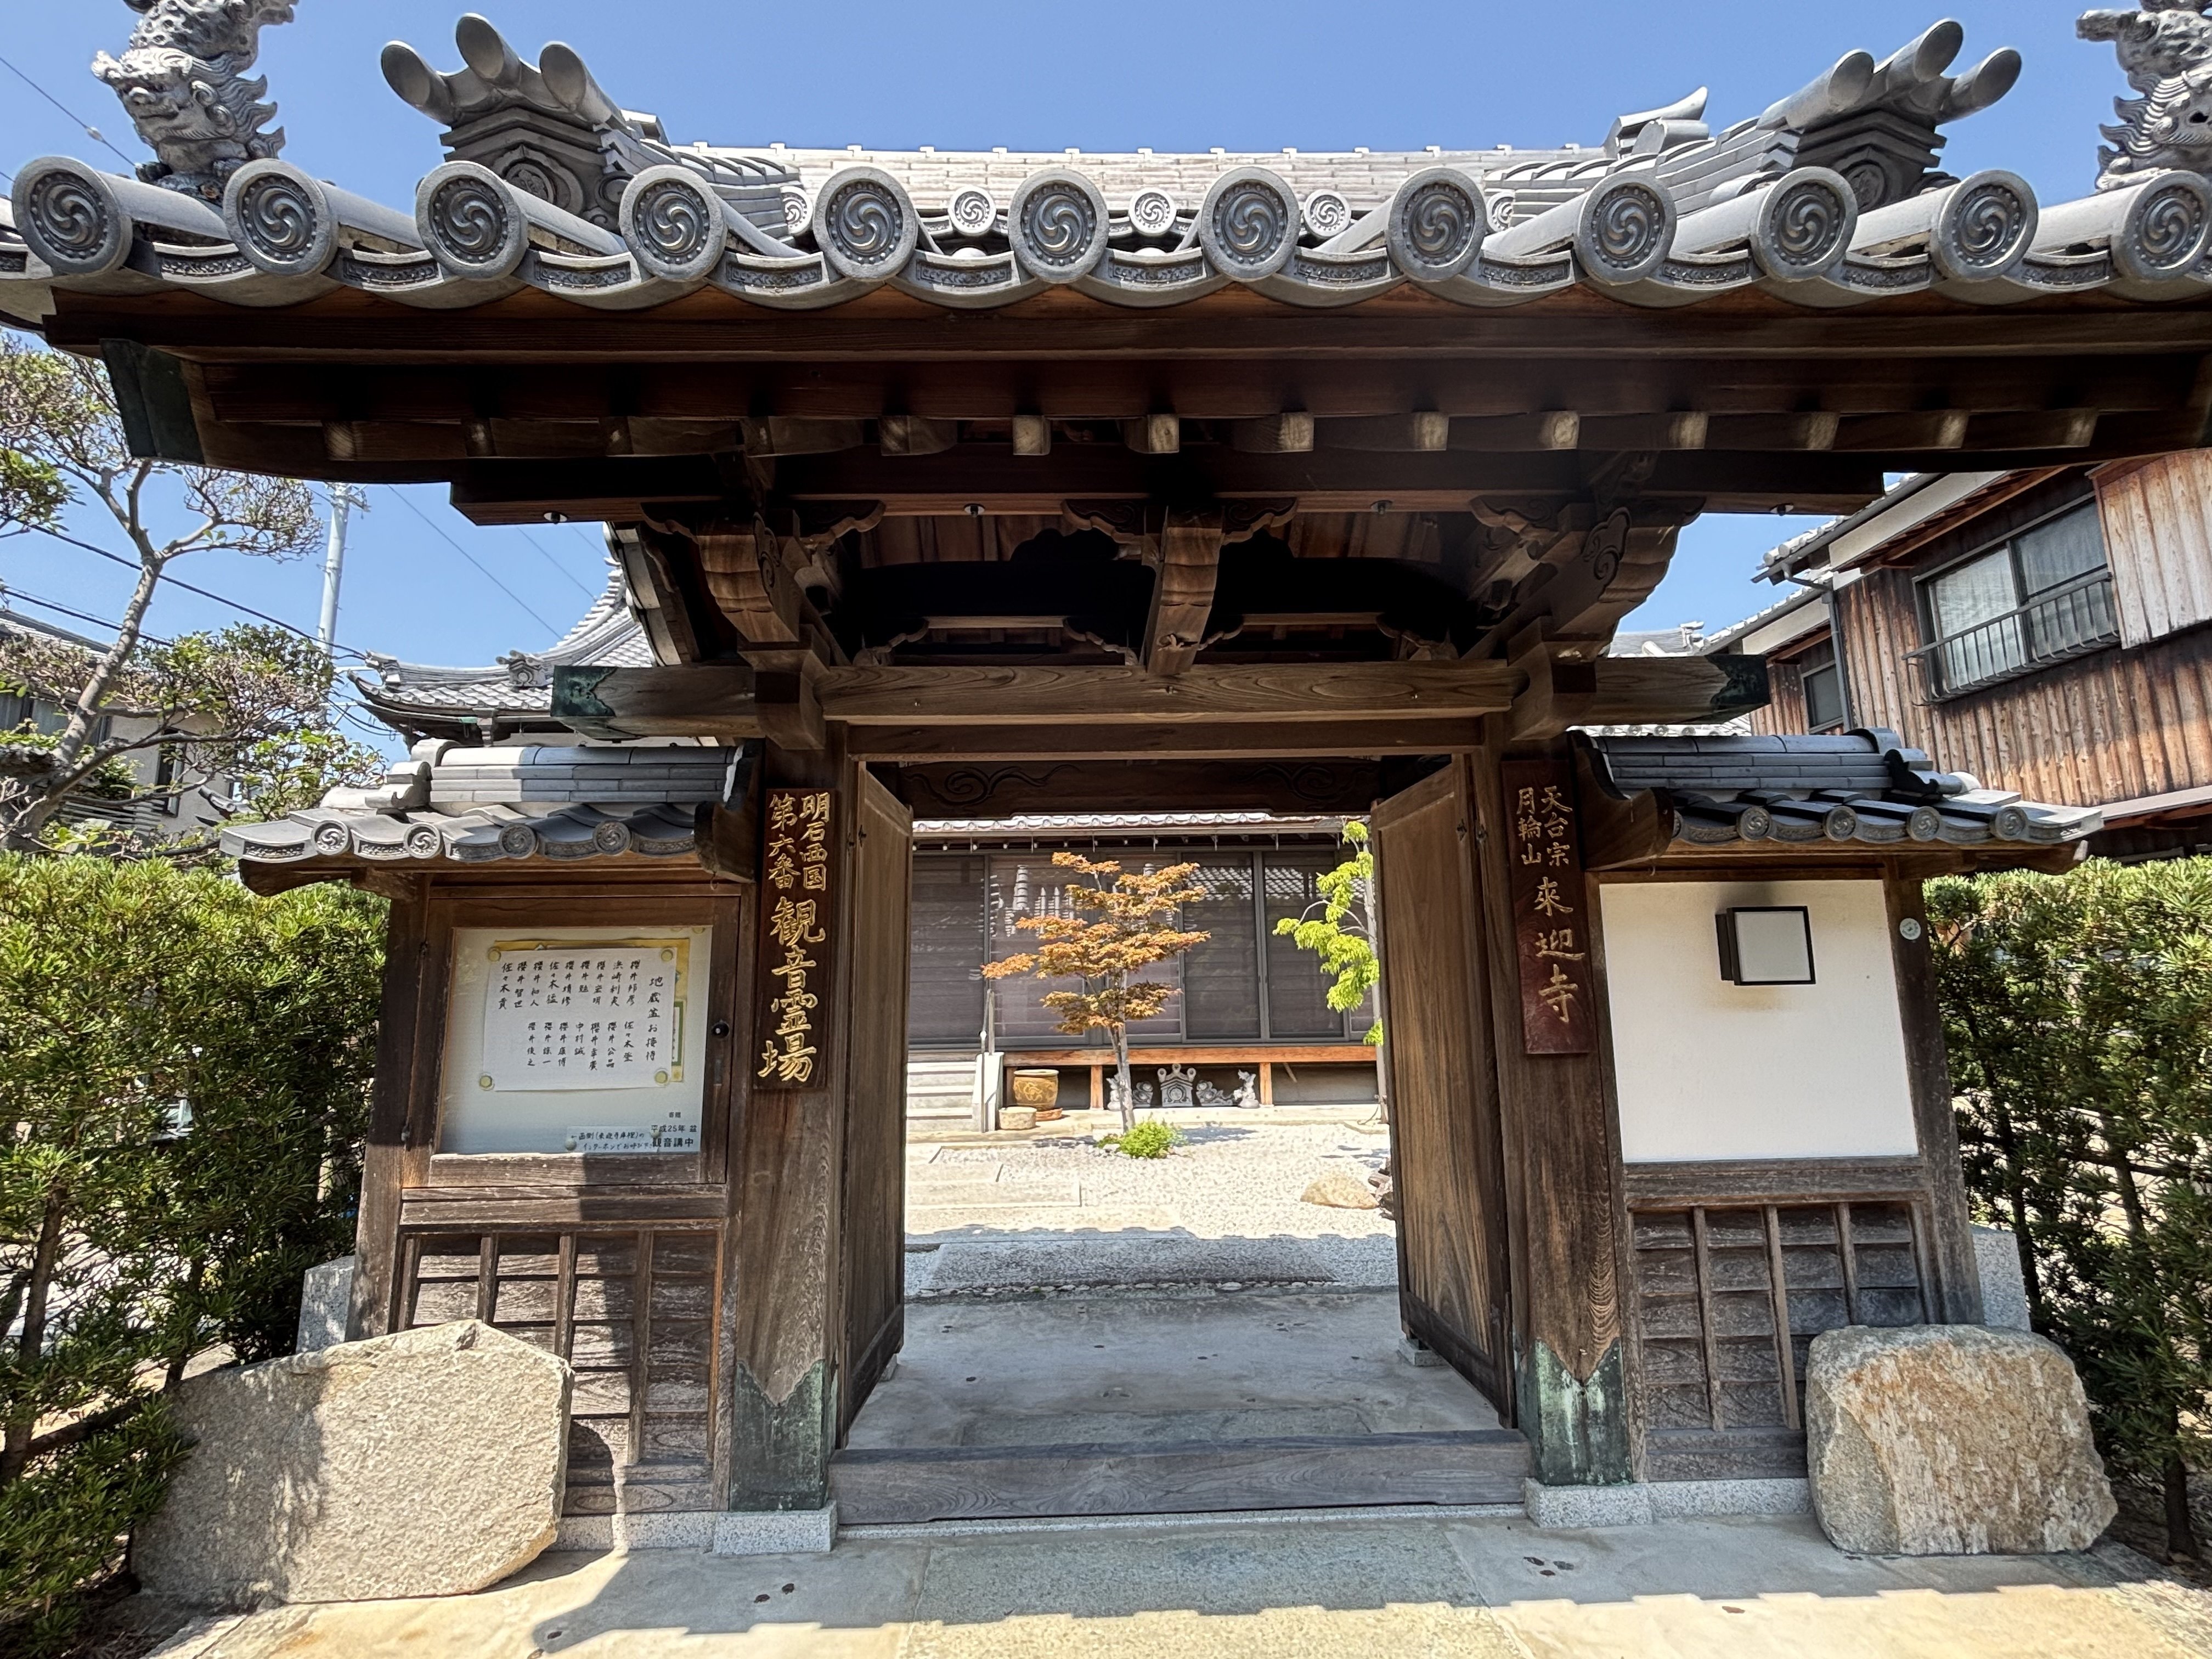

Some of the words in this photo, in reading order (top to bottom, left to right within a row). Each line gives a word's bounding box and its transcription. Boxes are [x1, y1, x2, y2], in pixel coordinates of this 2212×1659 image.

[769, 793, 800, 890] 第六番
[799, 792, 830, 891] 明石西国
[1516, 787, 1542, 865] 月輪山
[1541, 785, 1573, 867] 天台宗
